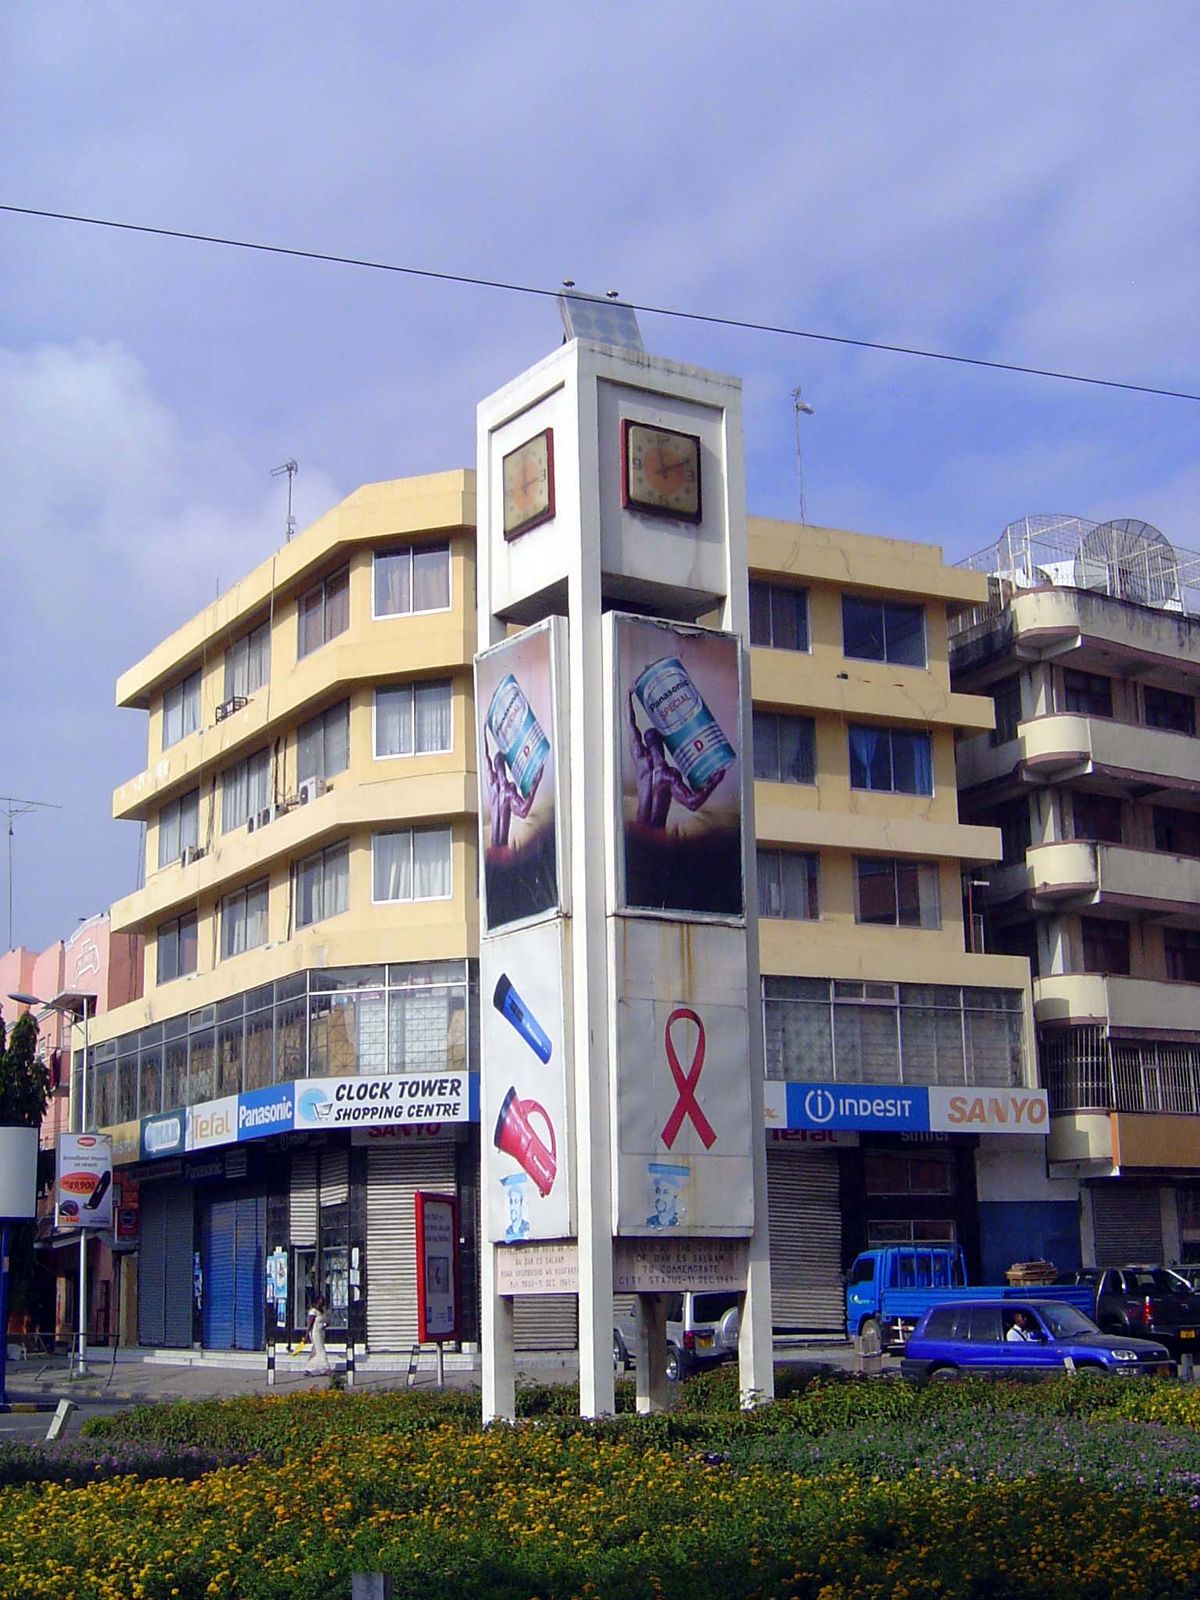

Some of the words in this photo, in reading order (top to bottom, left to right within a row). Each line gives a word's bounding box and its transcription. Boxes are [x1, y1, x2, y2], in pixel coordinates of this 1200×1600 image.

[649, 678, 690, 713] Panasonic
[659, 692, 692, 721] SPECIAL
[693, 739, 704, 752] D
[335, 1080, 394, 1101] CLOCK
[398, 1078, 462, 1099] TOWER
[239, 1096, 293, 1128] Panasonic
[334, 1105, 404, 1121] SHOPPING
[407, 1102, 461, 1119] CENTRE
[948, 1097, 1046, 1124] SANYO
[193, 1110, 231, 1139] Tefal
[643, 1265, 654, 1273] TO
[693, 1255, 724, 1263] SALAAM
[618, 1276, 641, 1284] CITY
